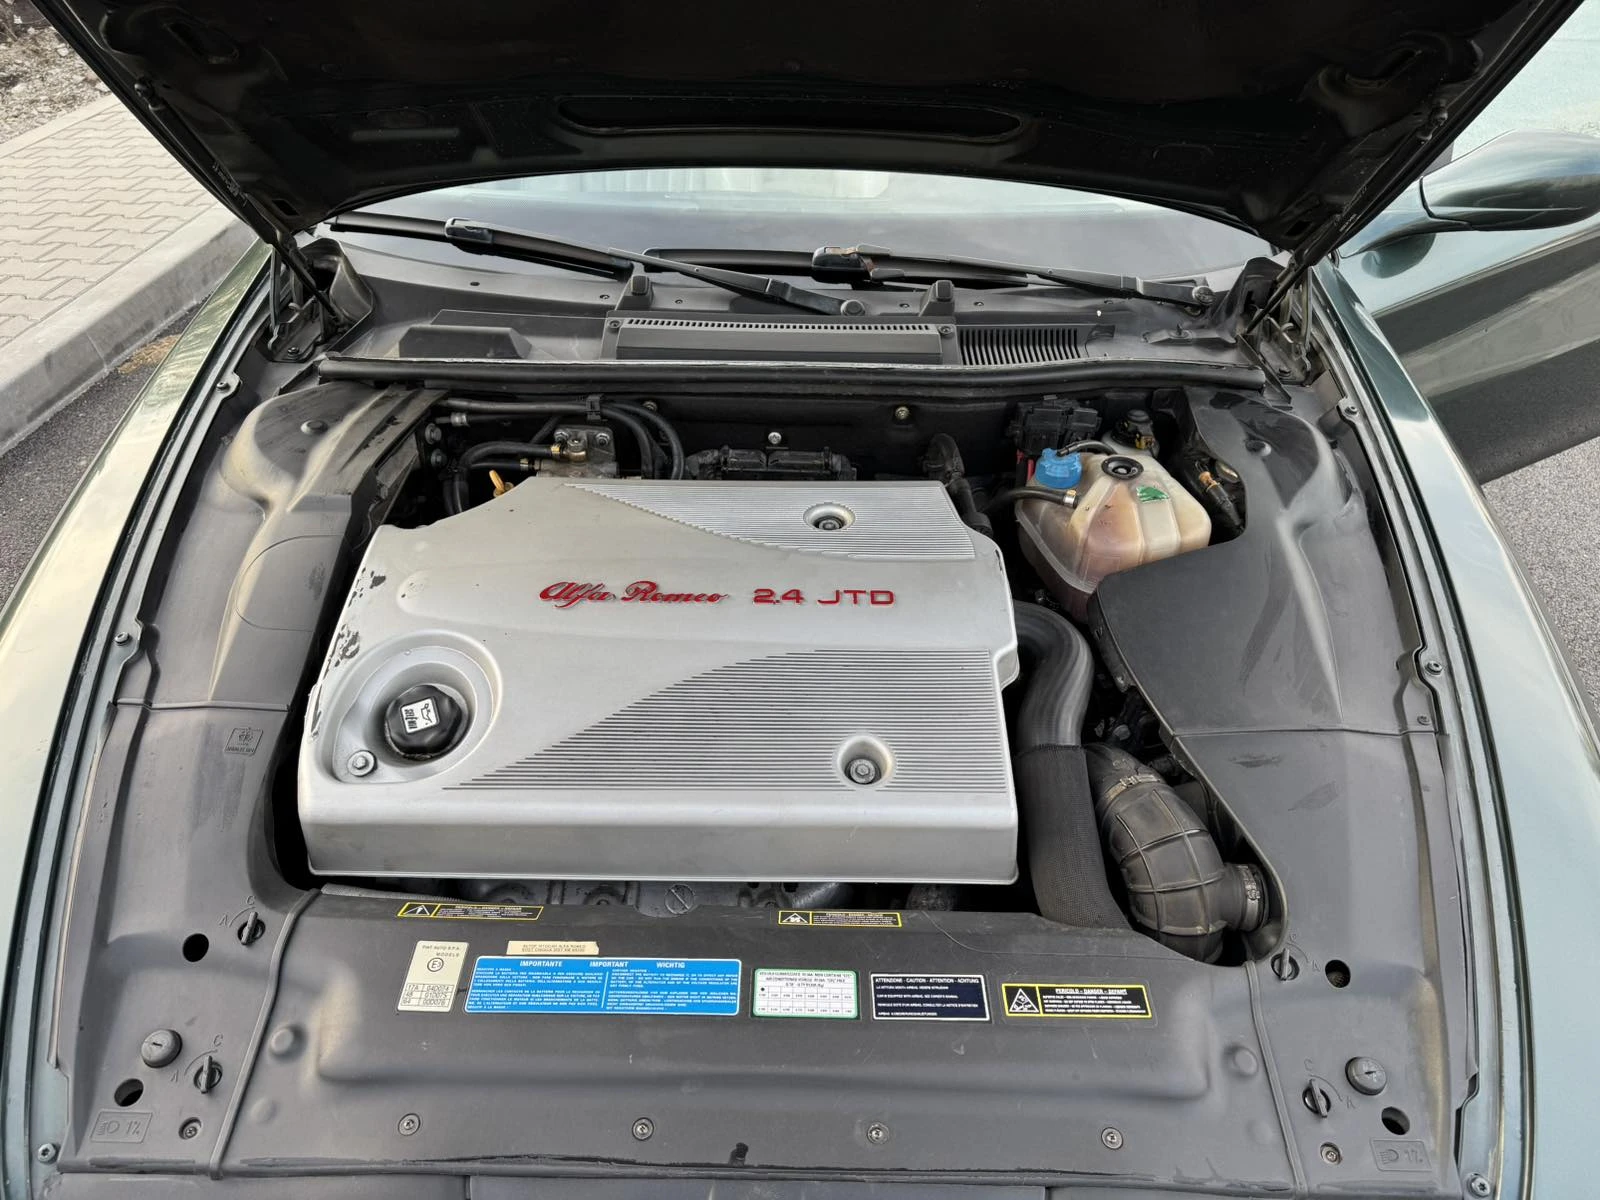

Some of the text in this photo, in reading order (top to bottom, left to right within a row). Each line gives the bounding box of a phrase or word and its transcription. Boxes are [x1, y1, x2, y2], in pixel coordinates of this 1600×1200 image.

[539, 580, 895, 609] Alfa Romeo 2.4 JTD
